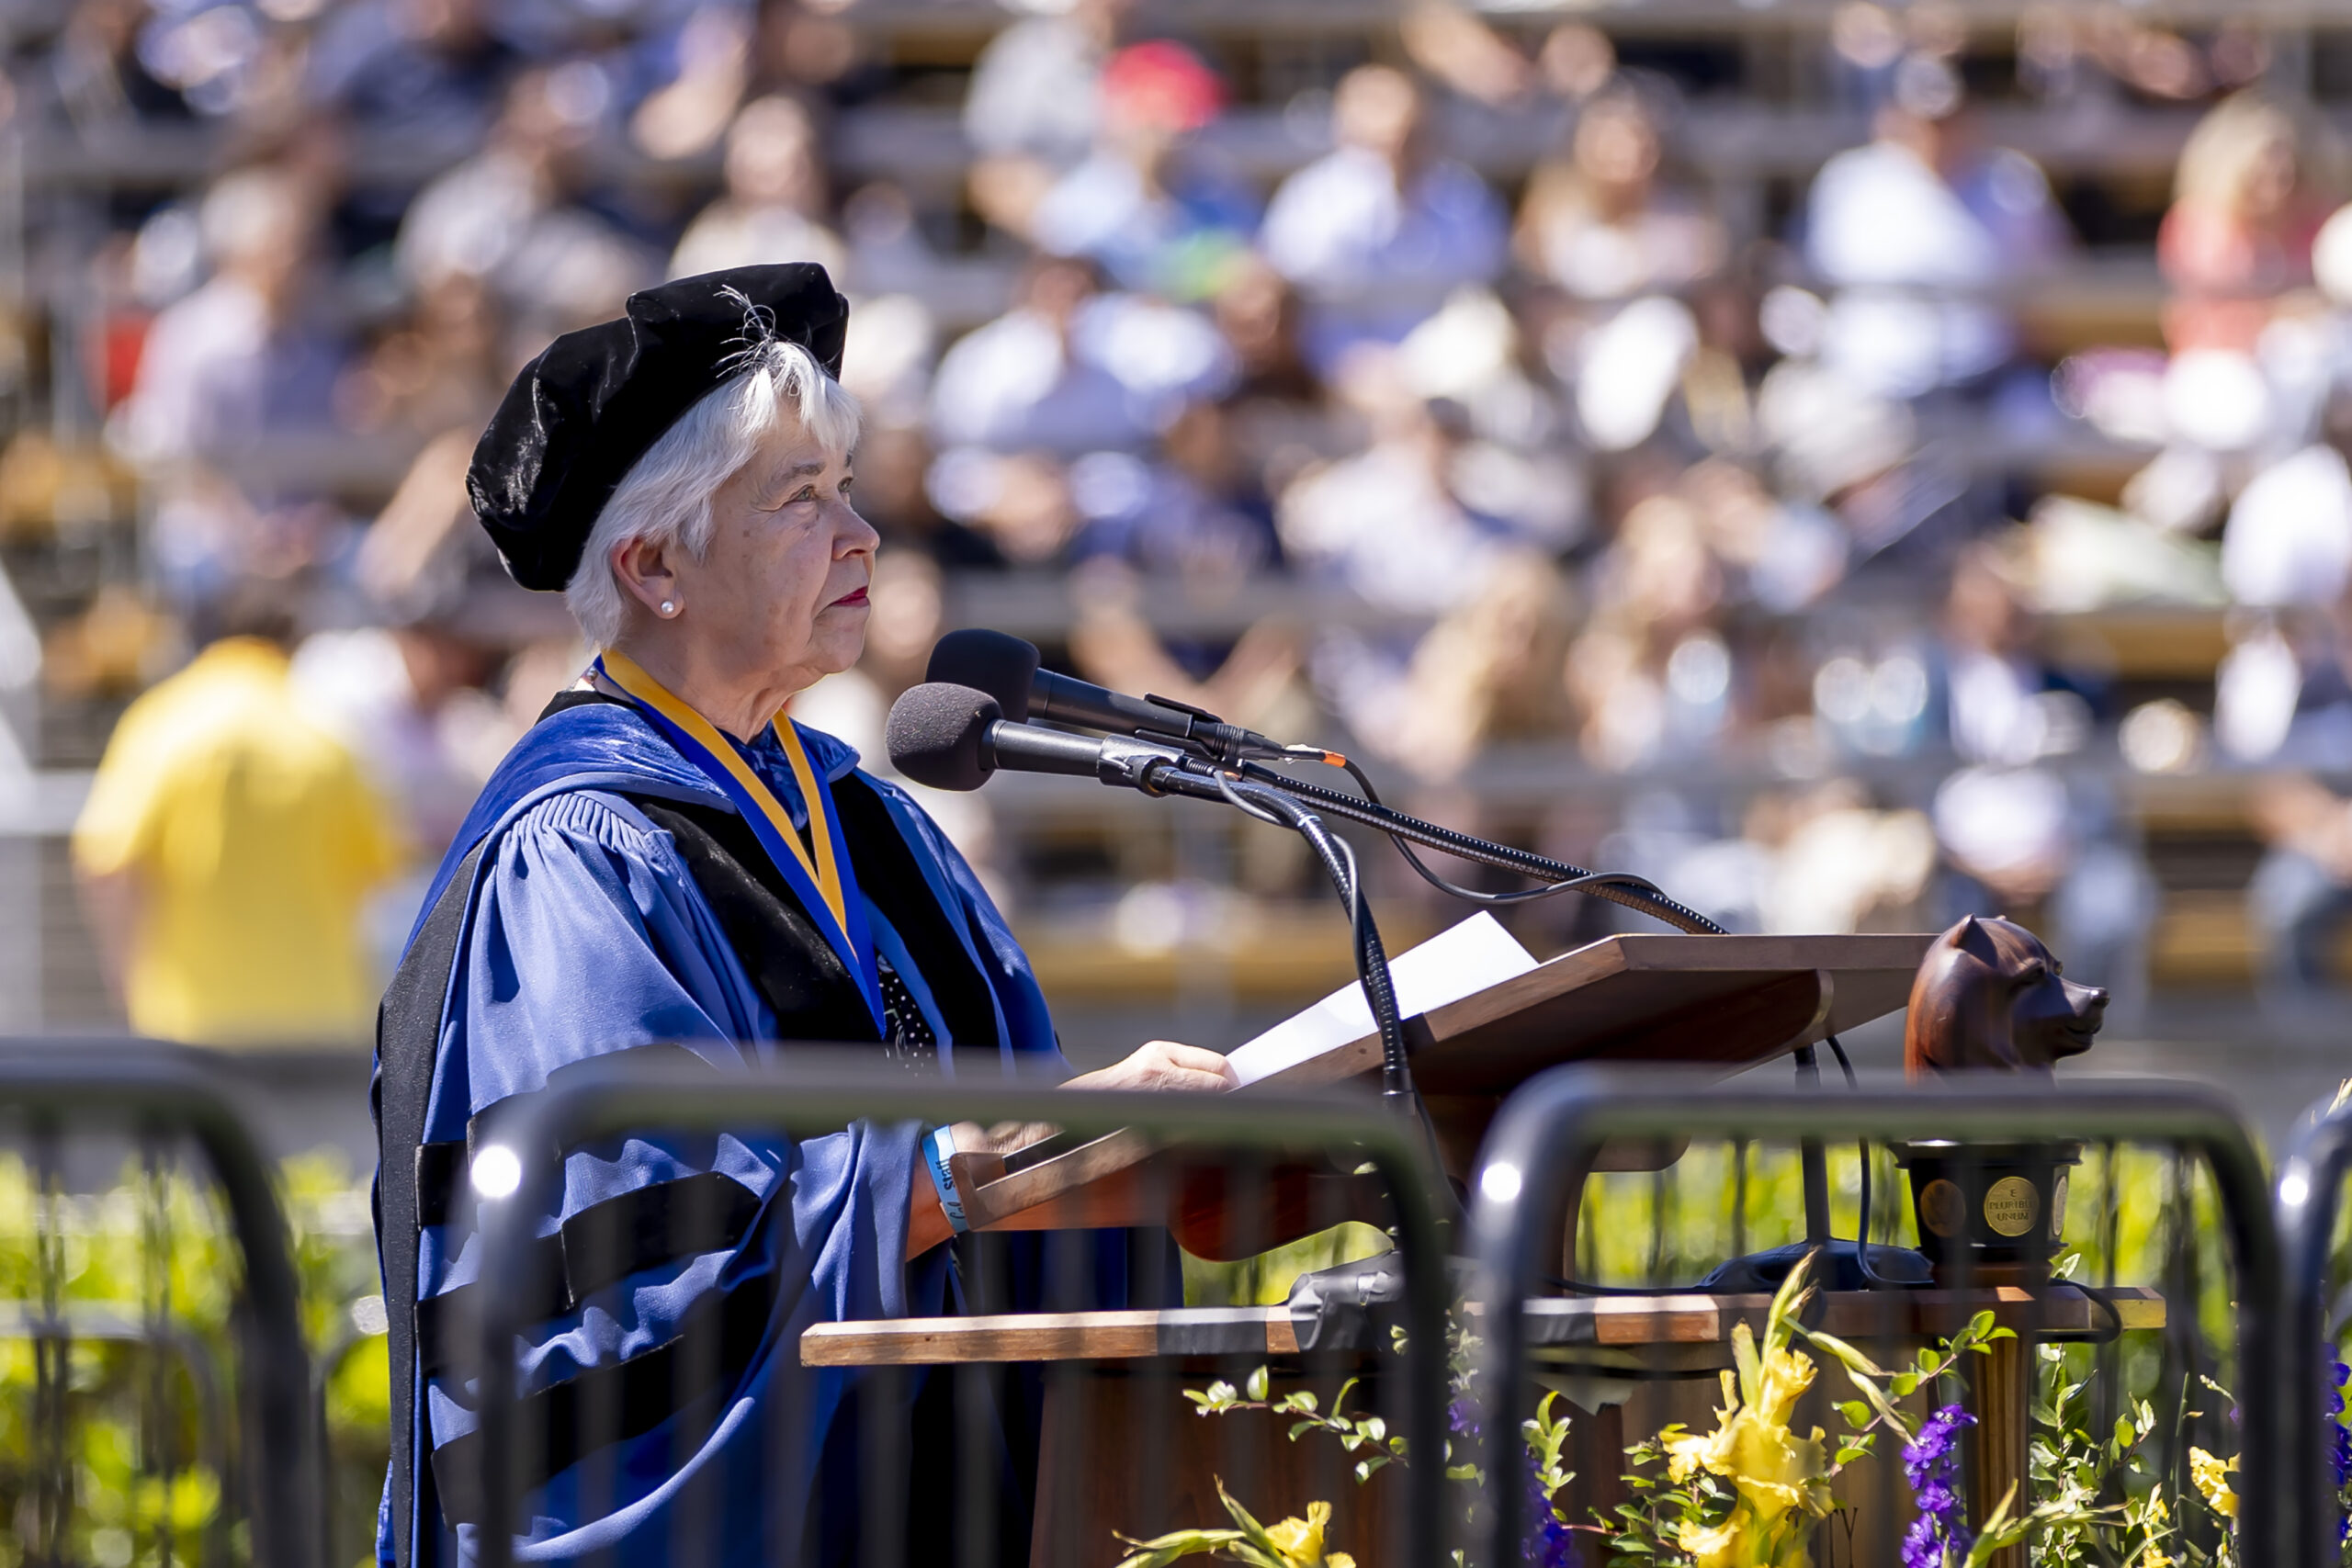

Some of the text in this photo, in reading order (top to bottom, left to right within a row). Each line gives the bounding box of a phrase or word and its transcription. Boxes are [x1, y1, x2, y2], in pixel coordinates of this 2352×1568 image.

[935, 1159, 955, 1191] Staff
[1989, 1199, 2036, 1210] PLURIBU
[1996, 1212, 2030, 1222] UNUM
